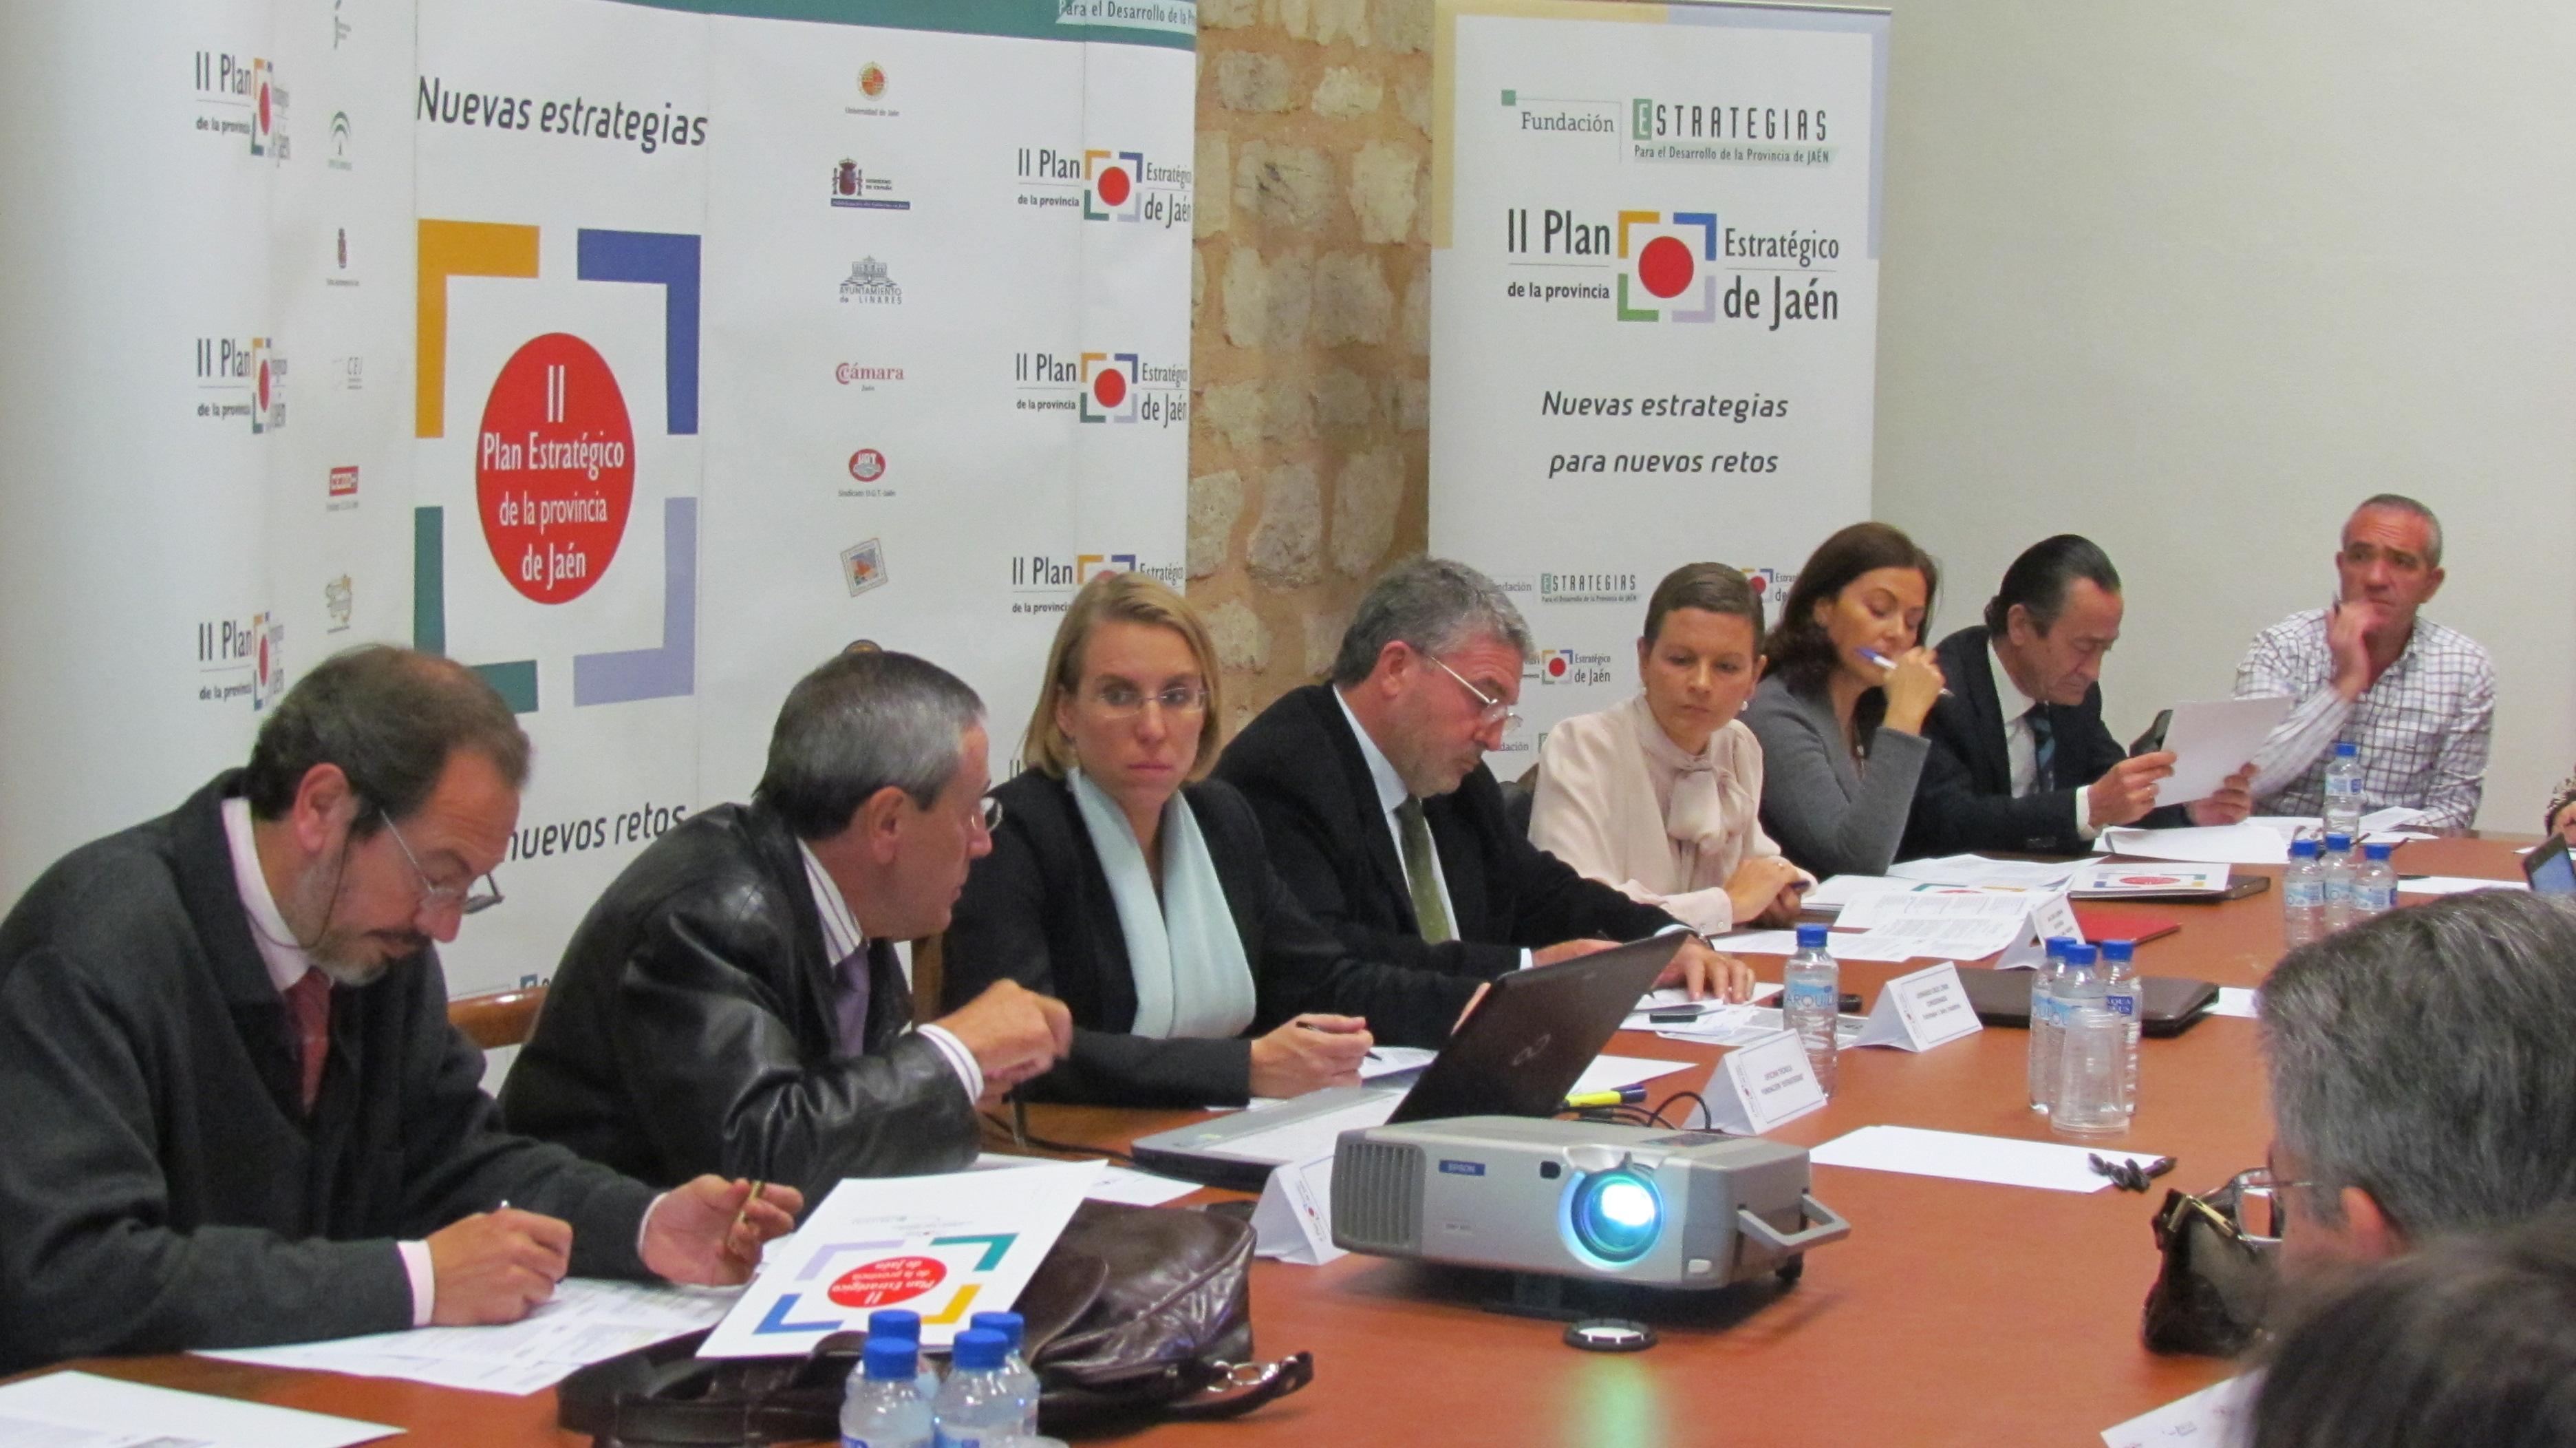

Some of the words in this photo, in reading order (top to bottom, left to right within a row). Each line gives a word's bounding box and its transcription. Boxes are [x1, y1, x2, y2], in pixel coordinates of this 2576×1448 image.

[1108, 1, 1164, 22] Desarrollo
[1168, 7, 1177, 23] de
[196, 51, 210, 91] II
[221, 53, 251, 96] Plan
[197, 116, 208, 130] de
[416, 75, 533, 131] Nuevas
[540, 96, 709, 154] estrategias
[1521, 110, 1614, 134] Fundación
[1635, 100, 1827, 142] ESTRATEGIAS
[1018, 148, 1030, 177] II
[1040, 149, 1080, 179] Plan
[1634, 145, 1655, 159] Para
[1657, 147, 1666, 159] el
[1669, 147, 1717, 160] Desarrollo
[1720, 148, 1732, 161] de
[1735, 148, 1743, 161] la
[1747, 149, 1790, 162] Provincia
[1793, 150, 1804, 162] de
[1807, 149, 1830, 165] JAÉN
[1018, 194, 1028, 204] de
[1030, 194, 1038, 205] la
[1040, 195, 1080, 207] provincia
[1145, 193, 1163, 220] de
[1508, 209, 1527, 253] II
[1544, 209, 1611, 255] Plan
[1725, 228, 1839, 267] Estratégico
[839, 286, 901, 297] AYUNTAMIENTO
[839, 295, 849, 304] de
[859, 295, 902, 304] LINARES
[1507, 281, 1525, 298] de
[1529, 281, 1541, 298] la
[1545, 282, 1610, 302] provincia
[1724, 275, 1760, 319] de
[1769, 275, 1838, 331] Jaén
[197, 338, 211, 377] II
[222, 338, 250, 377] Plan
[1016, 352, 1027, 381] II
[1037, 353, 1076, 382] Plan
[835, 362, 904, 385] Cámara
[547, 365, 565, 423] II
[1016, 399, 1026, 409] de
[1028, 399, 1035, 409] la
[1038, 399, 1076, 412] provincia
[1142, 392, 1160, 420] de
[1541, 391, 1633, 416] Nuevas
[1641, 393, 1789, 423] estrategias
[483, 432, 522, 471] Plan
[528, 431, 625, 480] Estratégico
[1548, 454, 1606, 480] para
[1613, 454, 1704, 473] nuevos
[1711, 451, 1779, 473] retos
[500, 490, 518, 526] de
[524, 490, 535, 525] la
[540, 490, 608, 535] provincia
[522, 543, 543, 582] de
[547, 542, 586, 590] Jaén
[1013, 557, 1024, 585] II
[1033, 557, 1073, 585] Plan
[1541, 574, 1635, 592] ESTRATEGIAS
[1012, 603, 1022, 613] de
[1024, 602, 1031, 613] la
[1033, 601, 1068, 615] provinci
[200, 622, 213, 661] II
[222, 621, 252, 659] Plan
[1575, 653, 1611, 666] Estratégico
[1574, 669, 1586, 682] de
[1588, 668, 1610, 686] Jaén
[614, 802, 687, 845] retos
